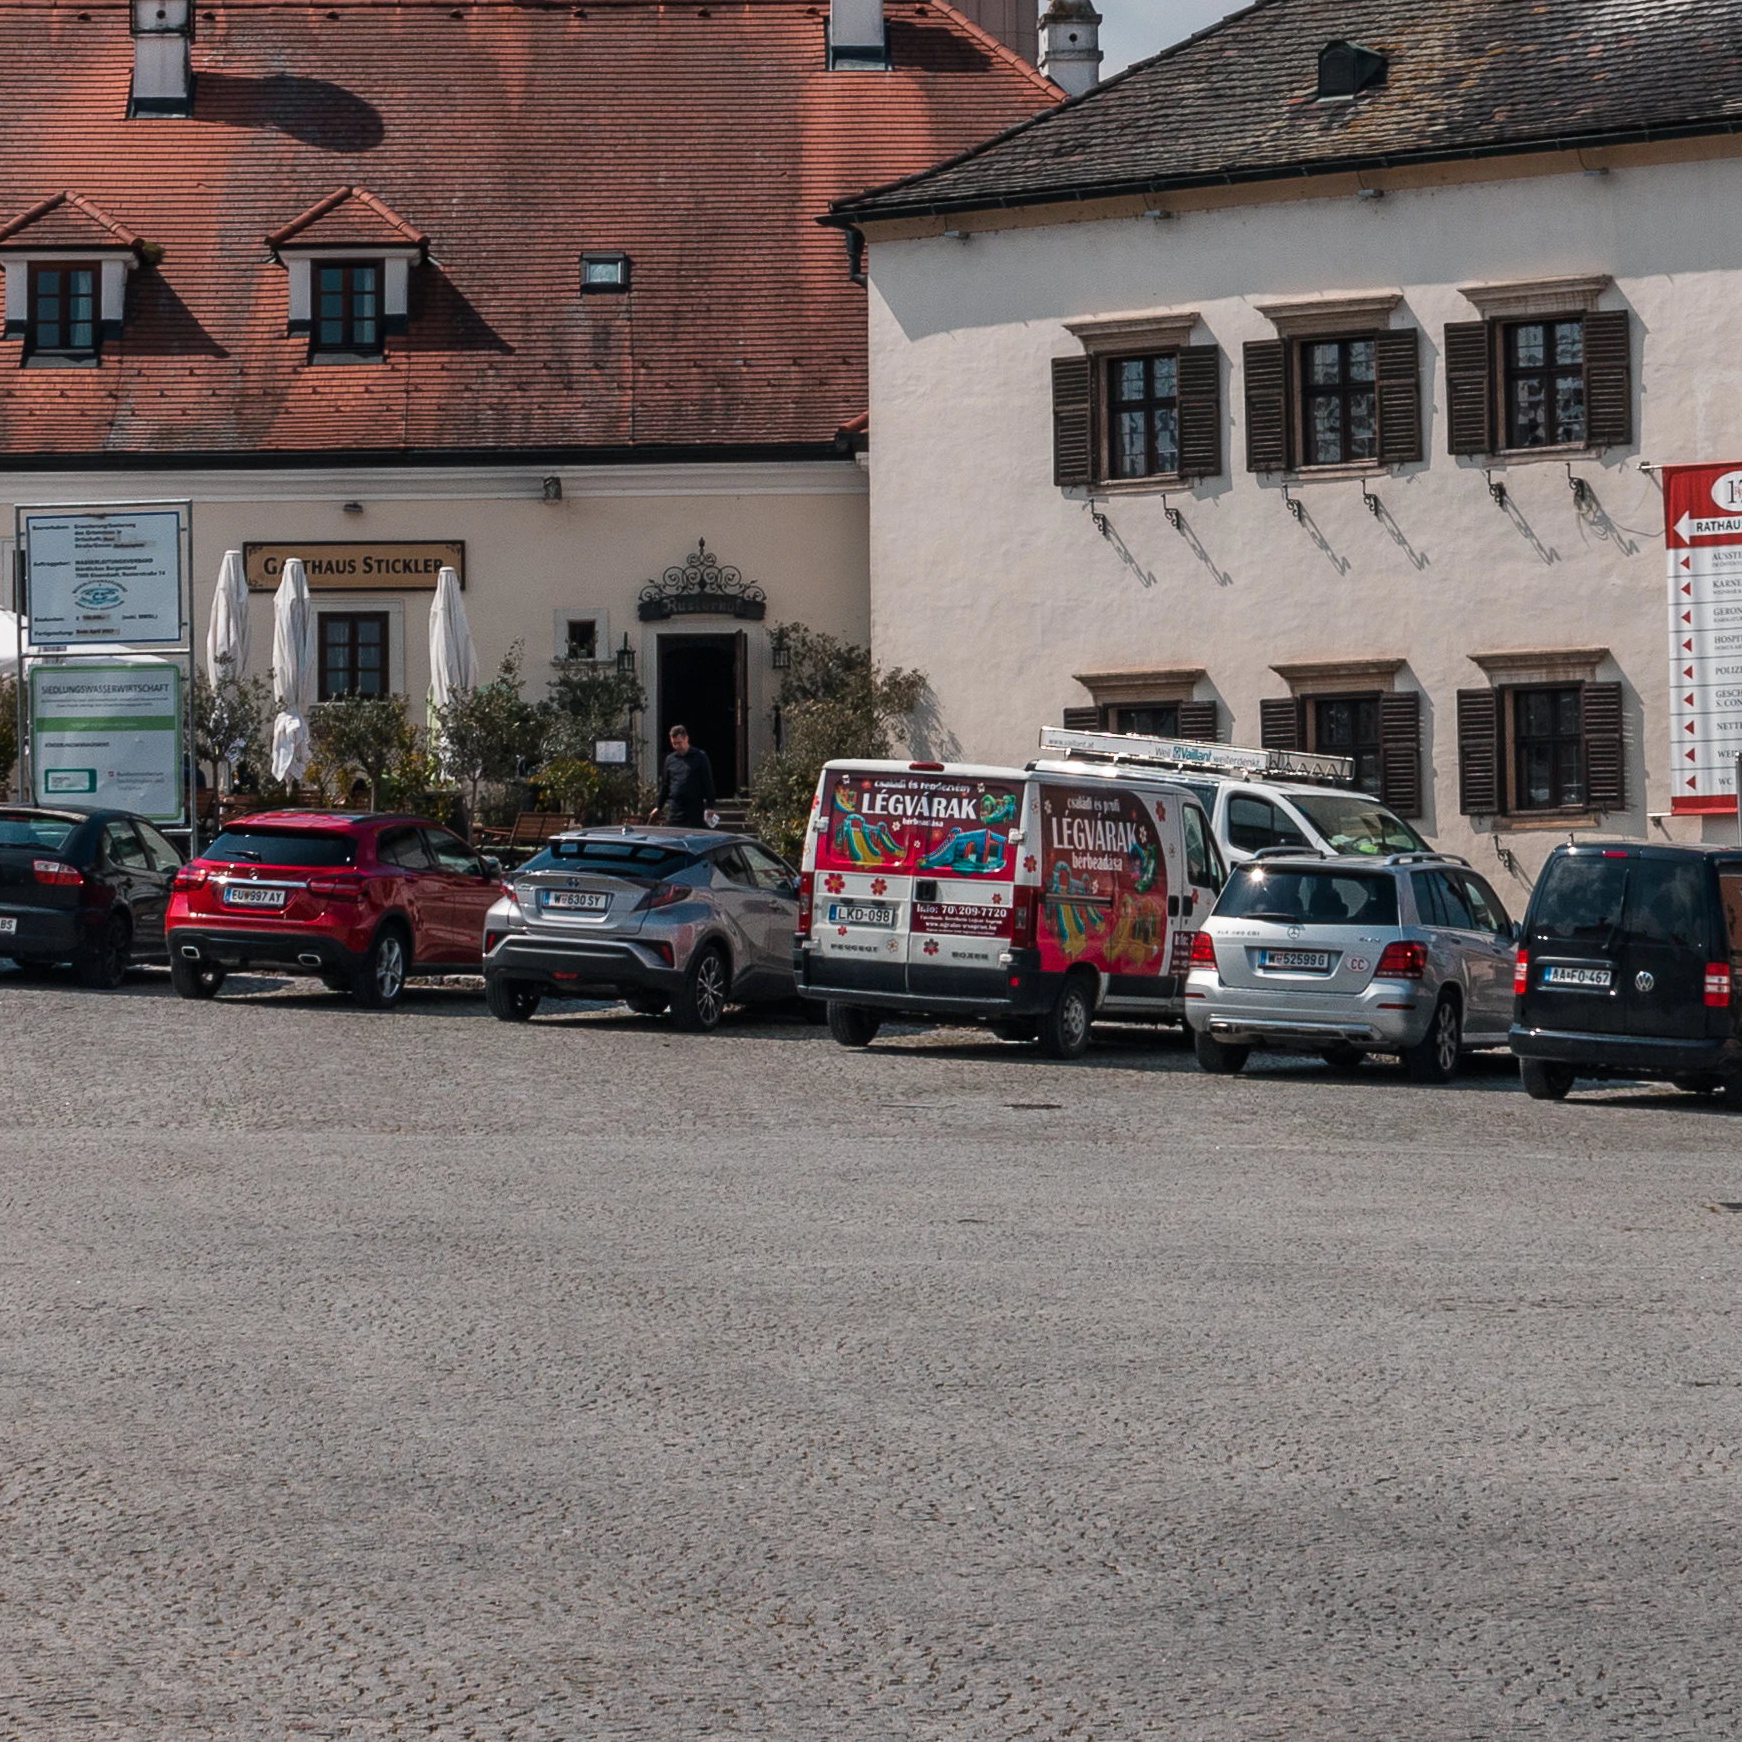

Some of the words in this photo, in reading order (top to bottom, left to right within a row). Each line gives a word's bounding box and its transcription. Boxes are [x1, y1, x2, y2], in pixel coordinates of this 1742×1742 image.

[263, 556, 357, 576] GTHAUS
[41, 683, 170, 695] SIEDLUNGSWASSERWIRTSCHAFT
[1155, 746, 1172, 757] Weil
[1181, 746, 1212, 760] Vaillant
[1718, 777, 1733, 786] WC
[861, 789, 977, 820] LÉGVÁRAK
[1051, 809, 1138, 853] LÉGVÁRAK
[1071, 852, 1123, 872] bérbeadása
[554, 893, 562, 904] W
[567, 893, 586, 905] 630
[587, 895, 601, 906] SY
[838, 907, 890, 923] LKD-098
[916, 903, 938, 914] Info:
[0, 919, 14, 930] BS
[830, 943, 879, 953] PEUGEOT
[951, 951, 989, 960] BOXER
[1268, 952, 1276, 963] W
[1284, 953, 1316, 965] 52599
[1317, 954, 1325, 965] G
[1350, 958, 1365, 970] CC
[1552, 968, 1567, 981] AA
